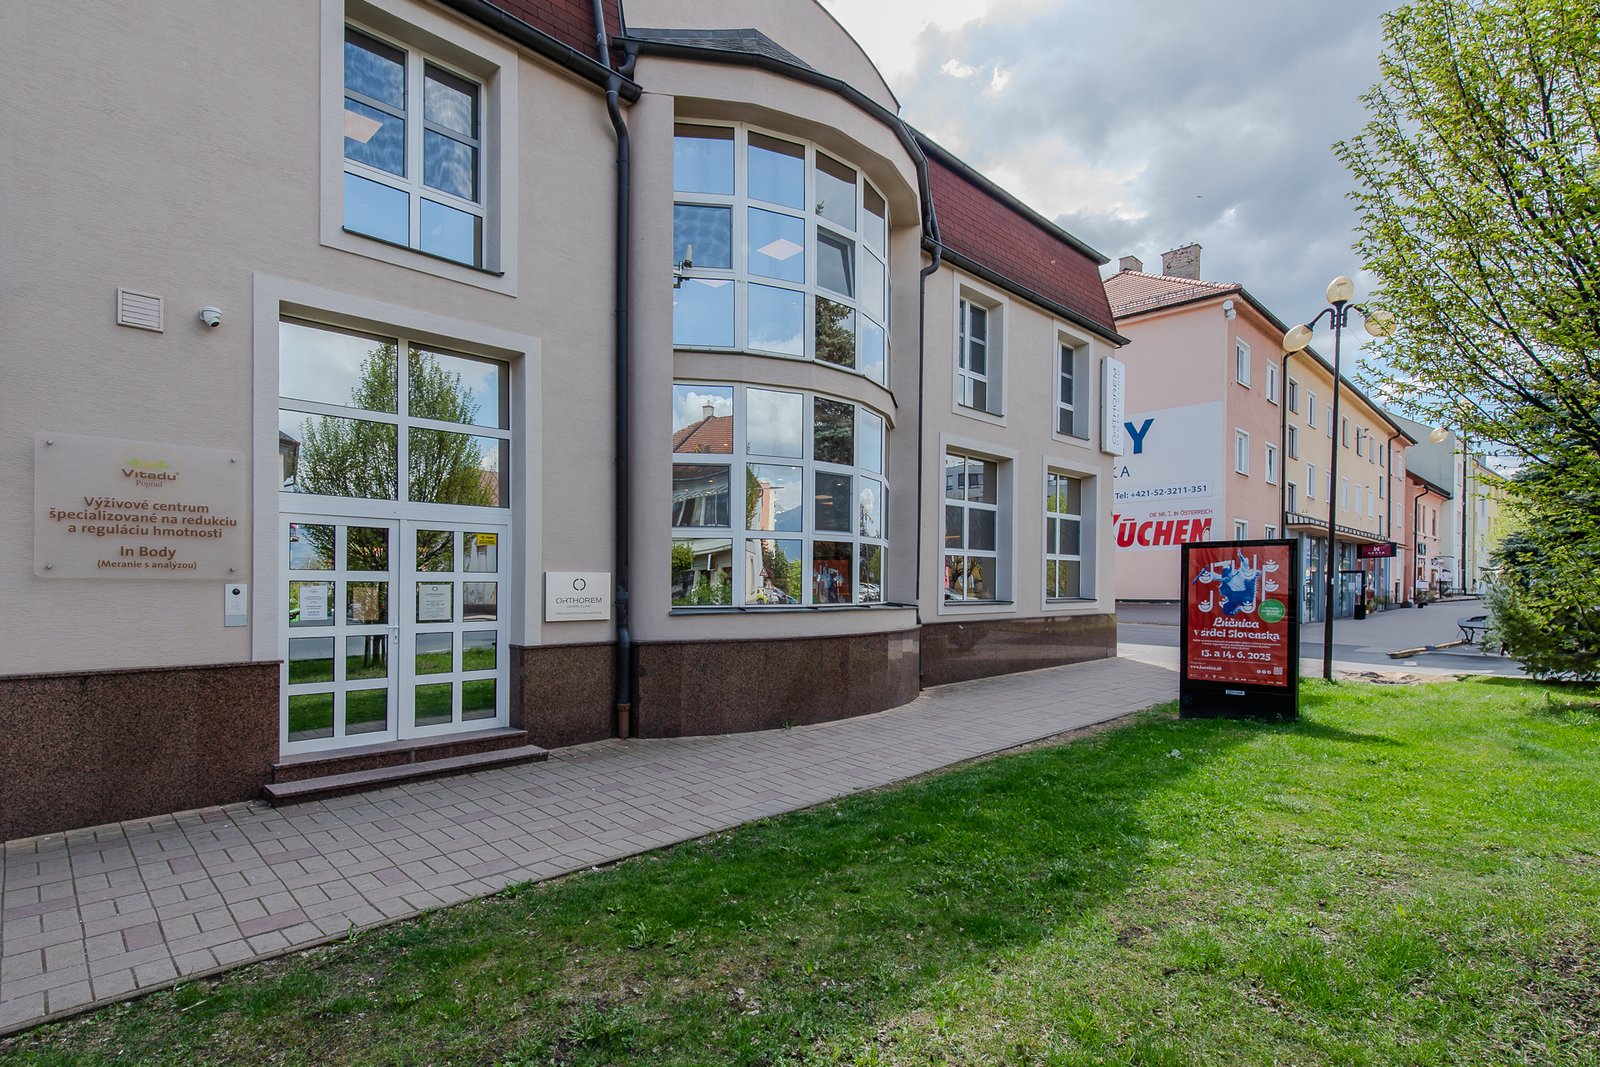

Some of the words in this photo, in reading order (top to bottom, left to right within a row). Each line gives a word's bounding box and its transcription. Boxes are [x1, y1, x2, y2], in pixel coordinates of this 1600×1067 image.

[121, 468, 177, 481] Vitadu
[136, 479, 163, 488] Poprad
[1115, 491, 1129, 499] Tel:
[1130, 485, 1207, 498] +421-52-3211-351
[84, 496, 149, 510] Výživové
[152, 501, 209, 513] centrum
[49, 507, 158, 523] špecializované
[161, 515, 178, 524] na
[182, 515, 237, 527] redukciu
[68, 524, 76, 533] a
[81, 523, 149, 537] reguláciu
[153, 525, 223, 538] hmotnosti
[120, 545, 134, 557] In
[139, 546, 177, 560] Body
[97, 559, 142, 569] (Meranie
[151, 560, 197, 570] analýzou)
[1213, 616, 1259, 629] Lúčnica
[1201, 628, 1226, 638] srdci
[1228, 629, 1281, 642] Slovenska
[1214, 650, 1221, 658] a
[1222, 650, 1235, 659] 14.
[1236, 650, 1246, 659] 6.
[1247, 652, 1271, 662] 2025
